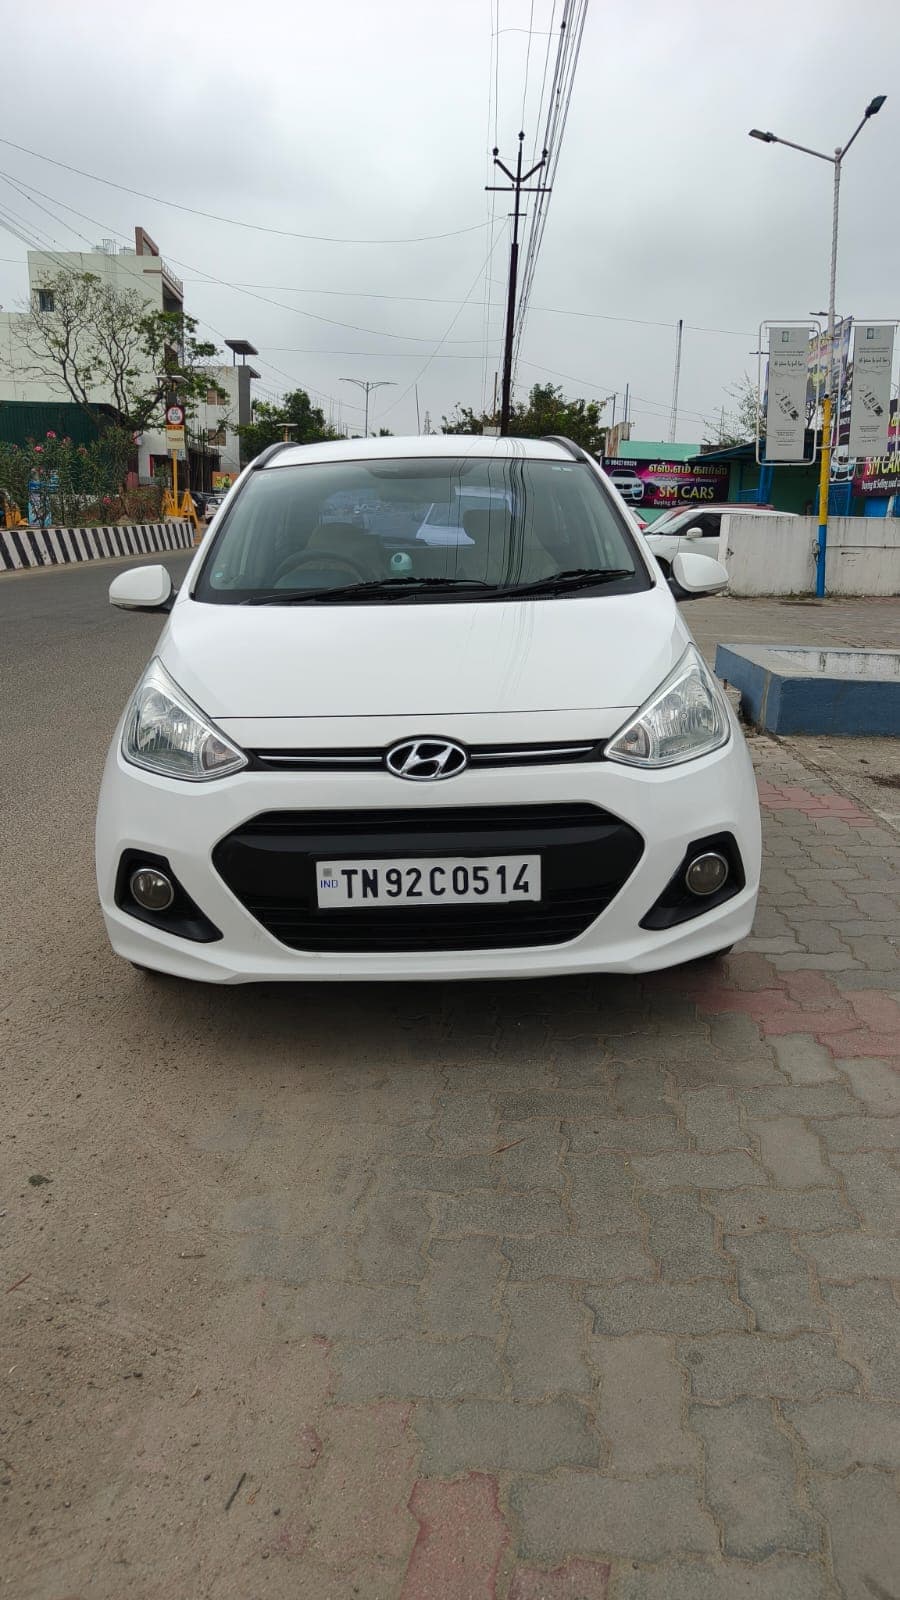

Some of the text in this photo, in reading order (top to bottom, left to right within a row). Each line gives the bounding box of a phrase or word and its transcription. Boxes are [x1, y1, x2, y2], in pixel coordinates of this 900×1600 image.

[866, 456, 880, 475] SM
[659, 485, 715, 499] SM CARS
[320, 880, 339, 889] IND
[341, 863, 530, 899] TN92C0514
